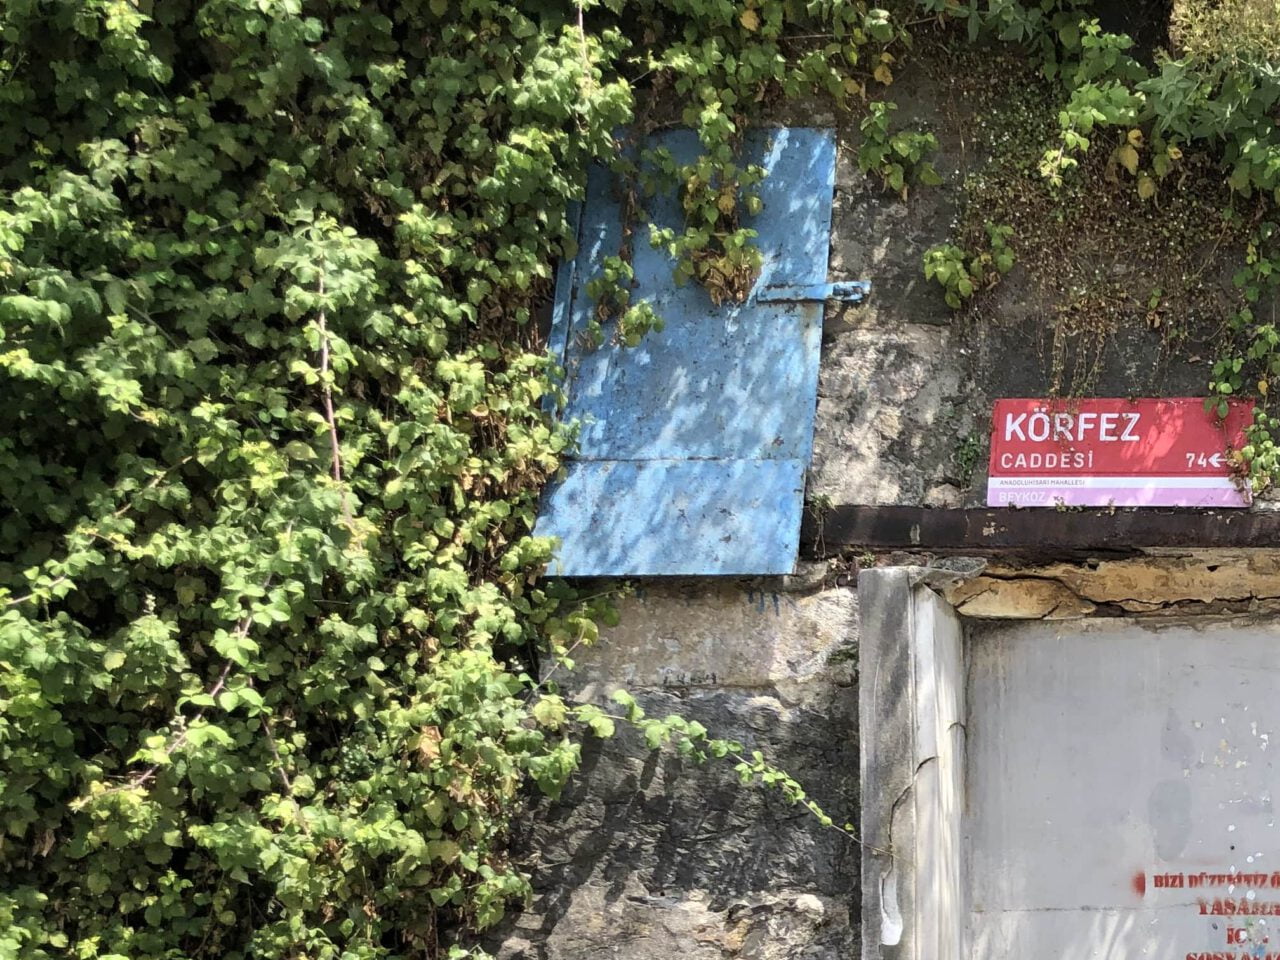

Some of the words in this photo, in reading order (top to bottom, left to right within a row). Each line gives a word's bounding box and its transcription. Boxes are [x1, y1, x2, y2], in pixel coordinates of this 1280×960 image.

[1004, 407, 1141, 442] KÖRFEZ
[1000, 450, 1094, 469] CADDESİ
[1185, 452, 1208, 468] 74
[999, 491, 1046, 503] BEYKOZ
[1153, 871, 1184, 888] BİZİ
